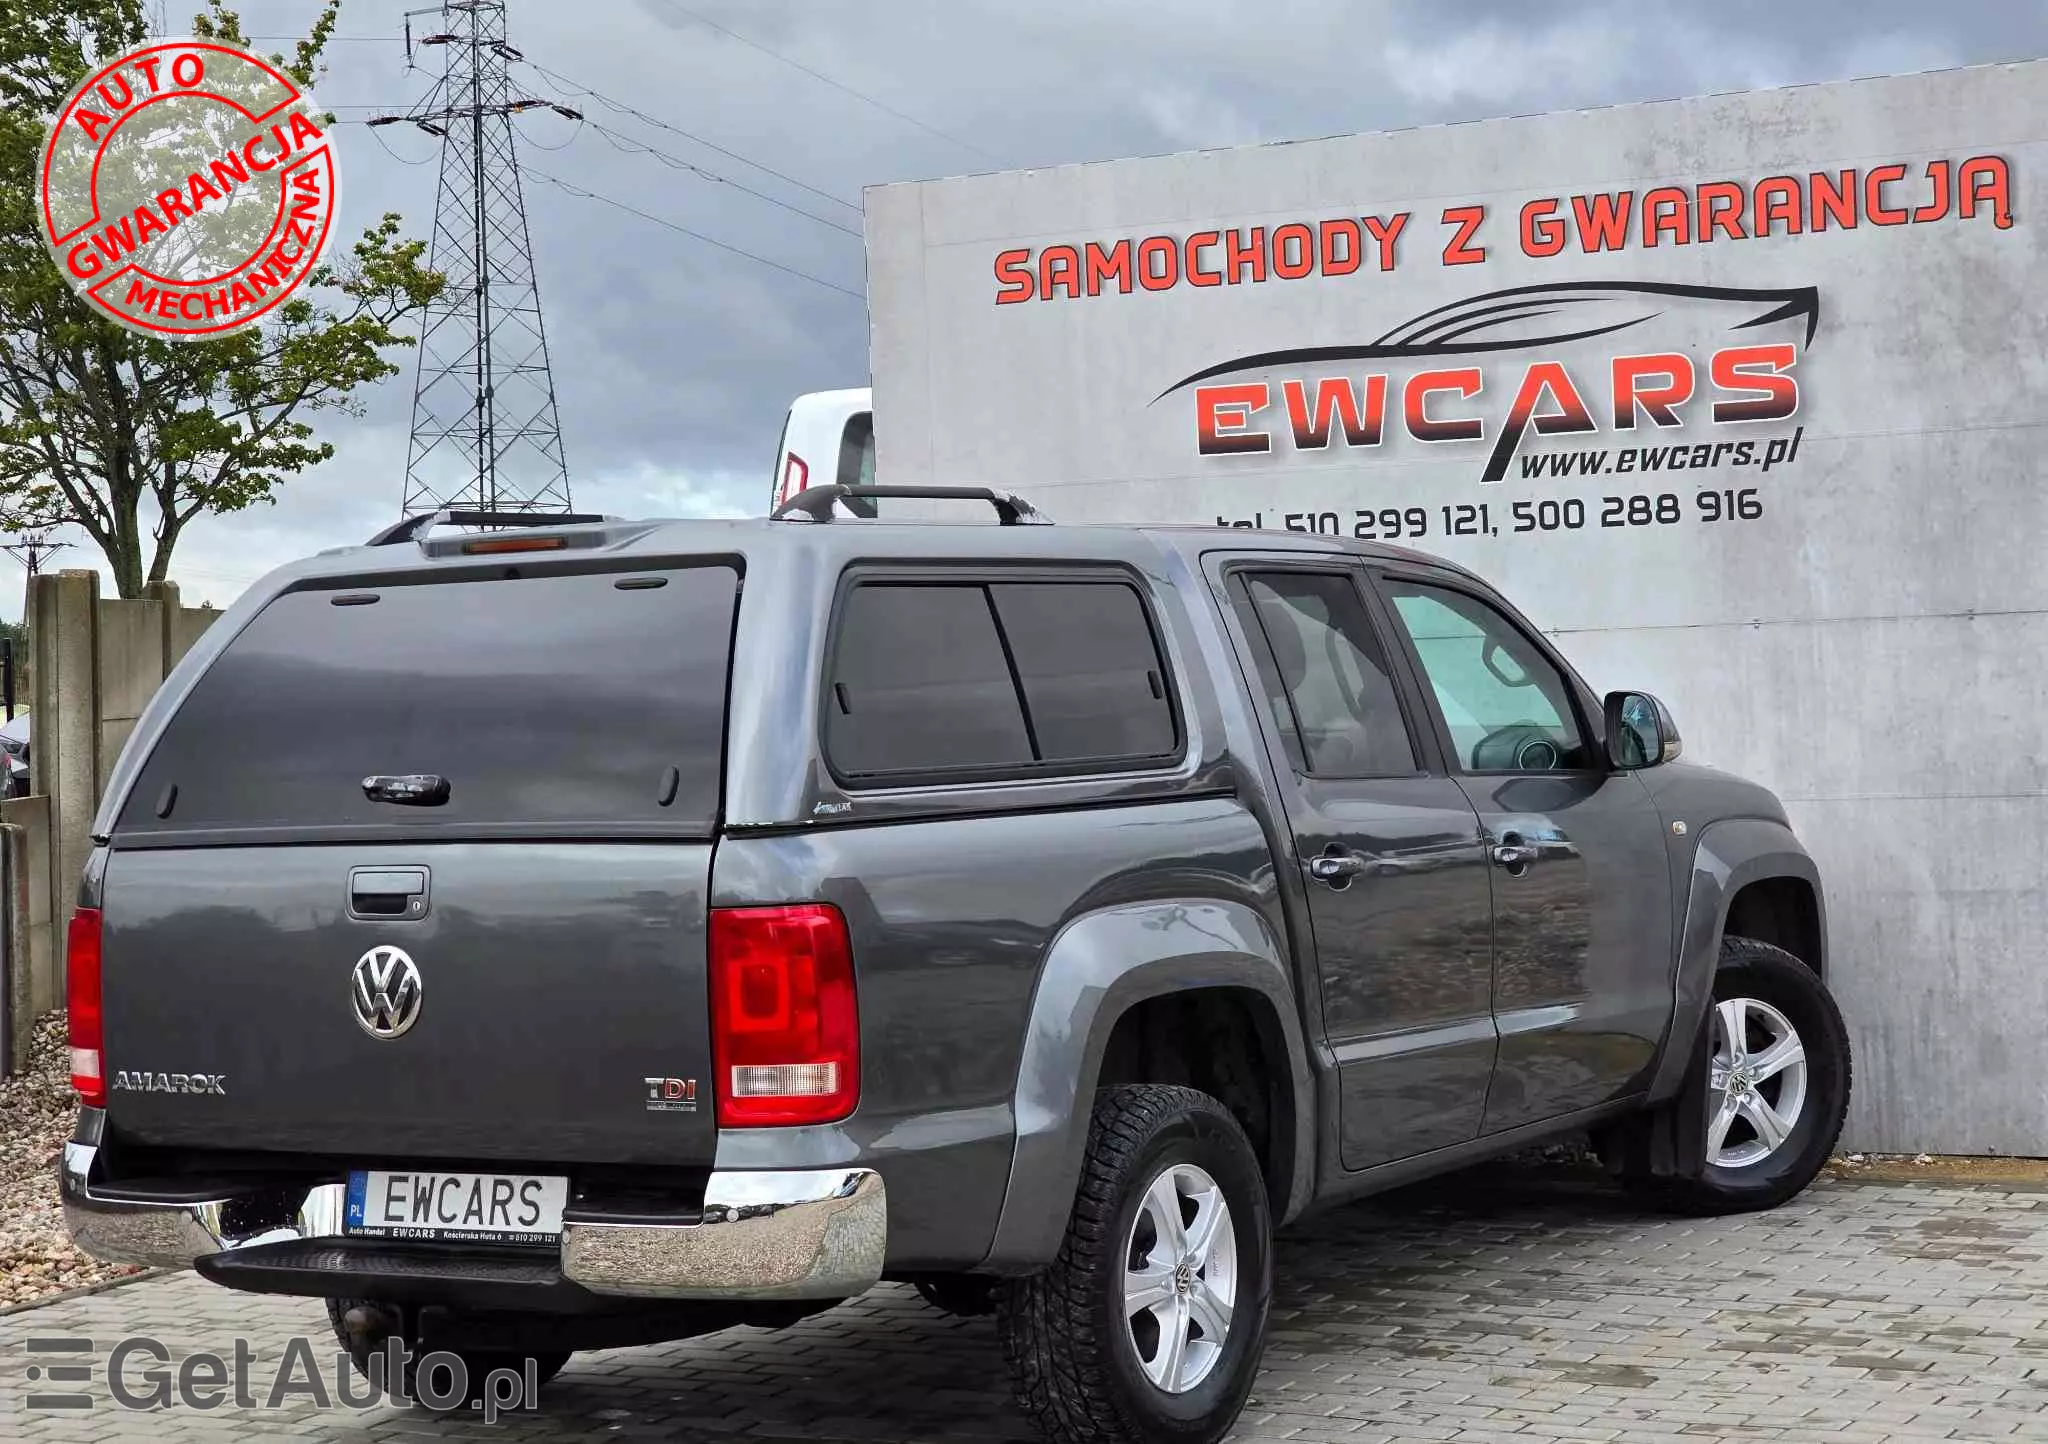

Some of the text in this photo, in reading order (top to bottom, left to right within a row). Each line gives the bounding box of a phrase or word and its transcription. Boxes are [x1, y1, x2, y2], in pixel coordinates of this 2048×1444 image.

[994, 155, 2014, 306] SAMOCHODY Z GWARANCJĄ
[1196, 344, 1798, 484] EWCARS
[1521, 427, 1803, 479] www.ewcars.pl
[1354, 507, 1427, 539] 299
[1441, 503, 1498, 538] 121,
[1512, 498, 1585, 532] 500
[1601, 493, 1681, 527] 288
[1696, 488, 1763, 522] 916
[112, 1071, 226, 1095] AMAROK
[644, 1077, 696, 1099] TDI
[350, 1204, 362, 1217] PL
[384, 1175, 543, 1227] EWCARS
[392, 1227, 436, 1239] EWCARS
